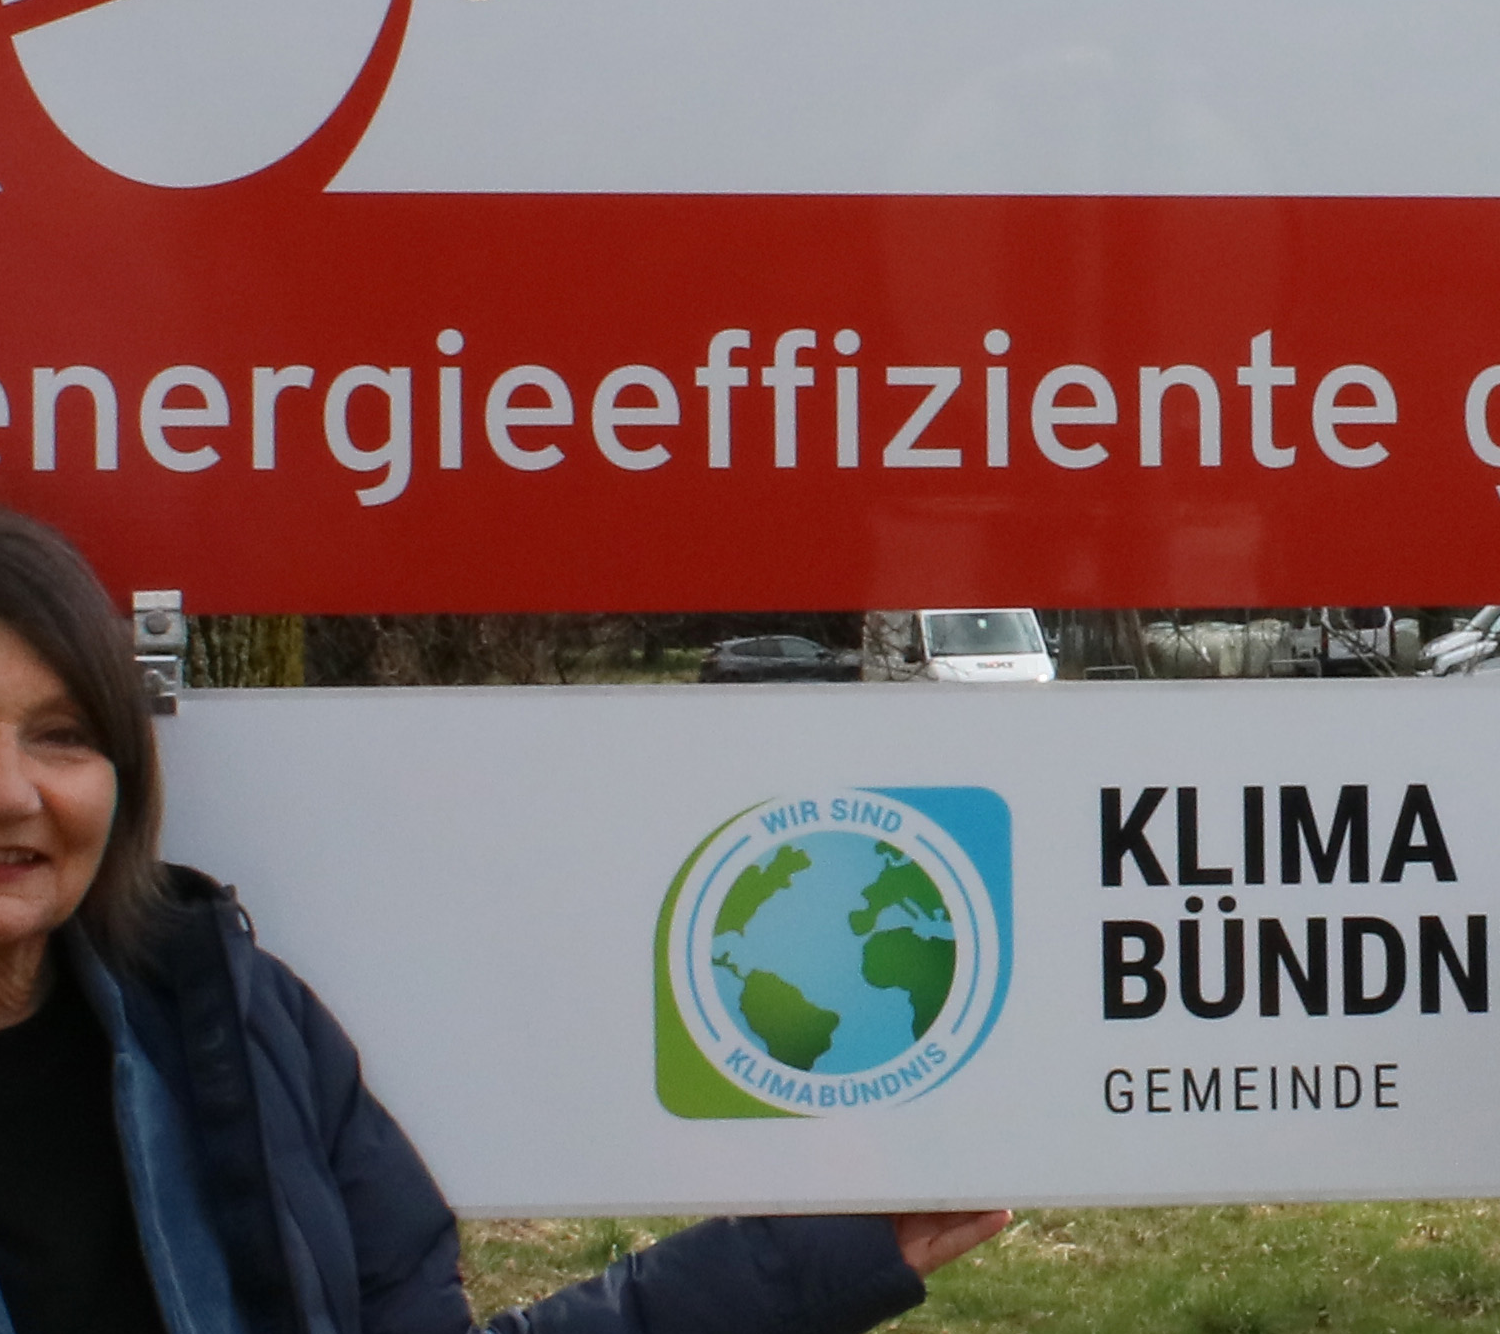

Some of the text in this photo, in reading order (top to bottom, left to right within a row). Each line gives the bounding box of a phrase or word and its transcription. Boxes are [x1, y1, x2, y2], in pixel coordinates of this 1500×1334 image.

[760, 797, 904, 836] WIR SIND
[1100, 784, 1459, 888] KLIMA
[724, 1041, 948, 1108] KLIMABÜNDNIS
[1104, 1063, 1400, 1114] GEMEINDE
